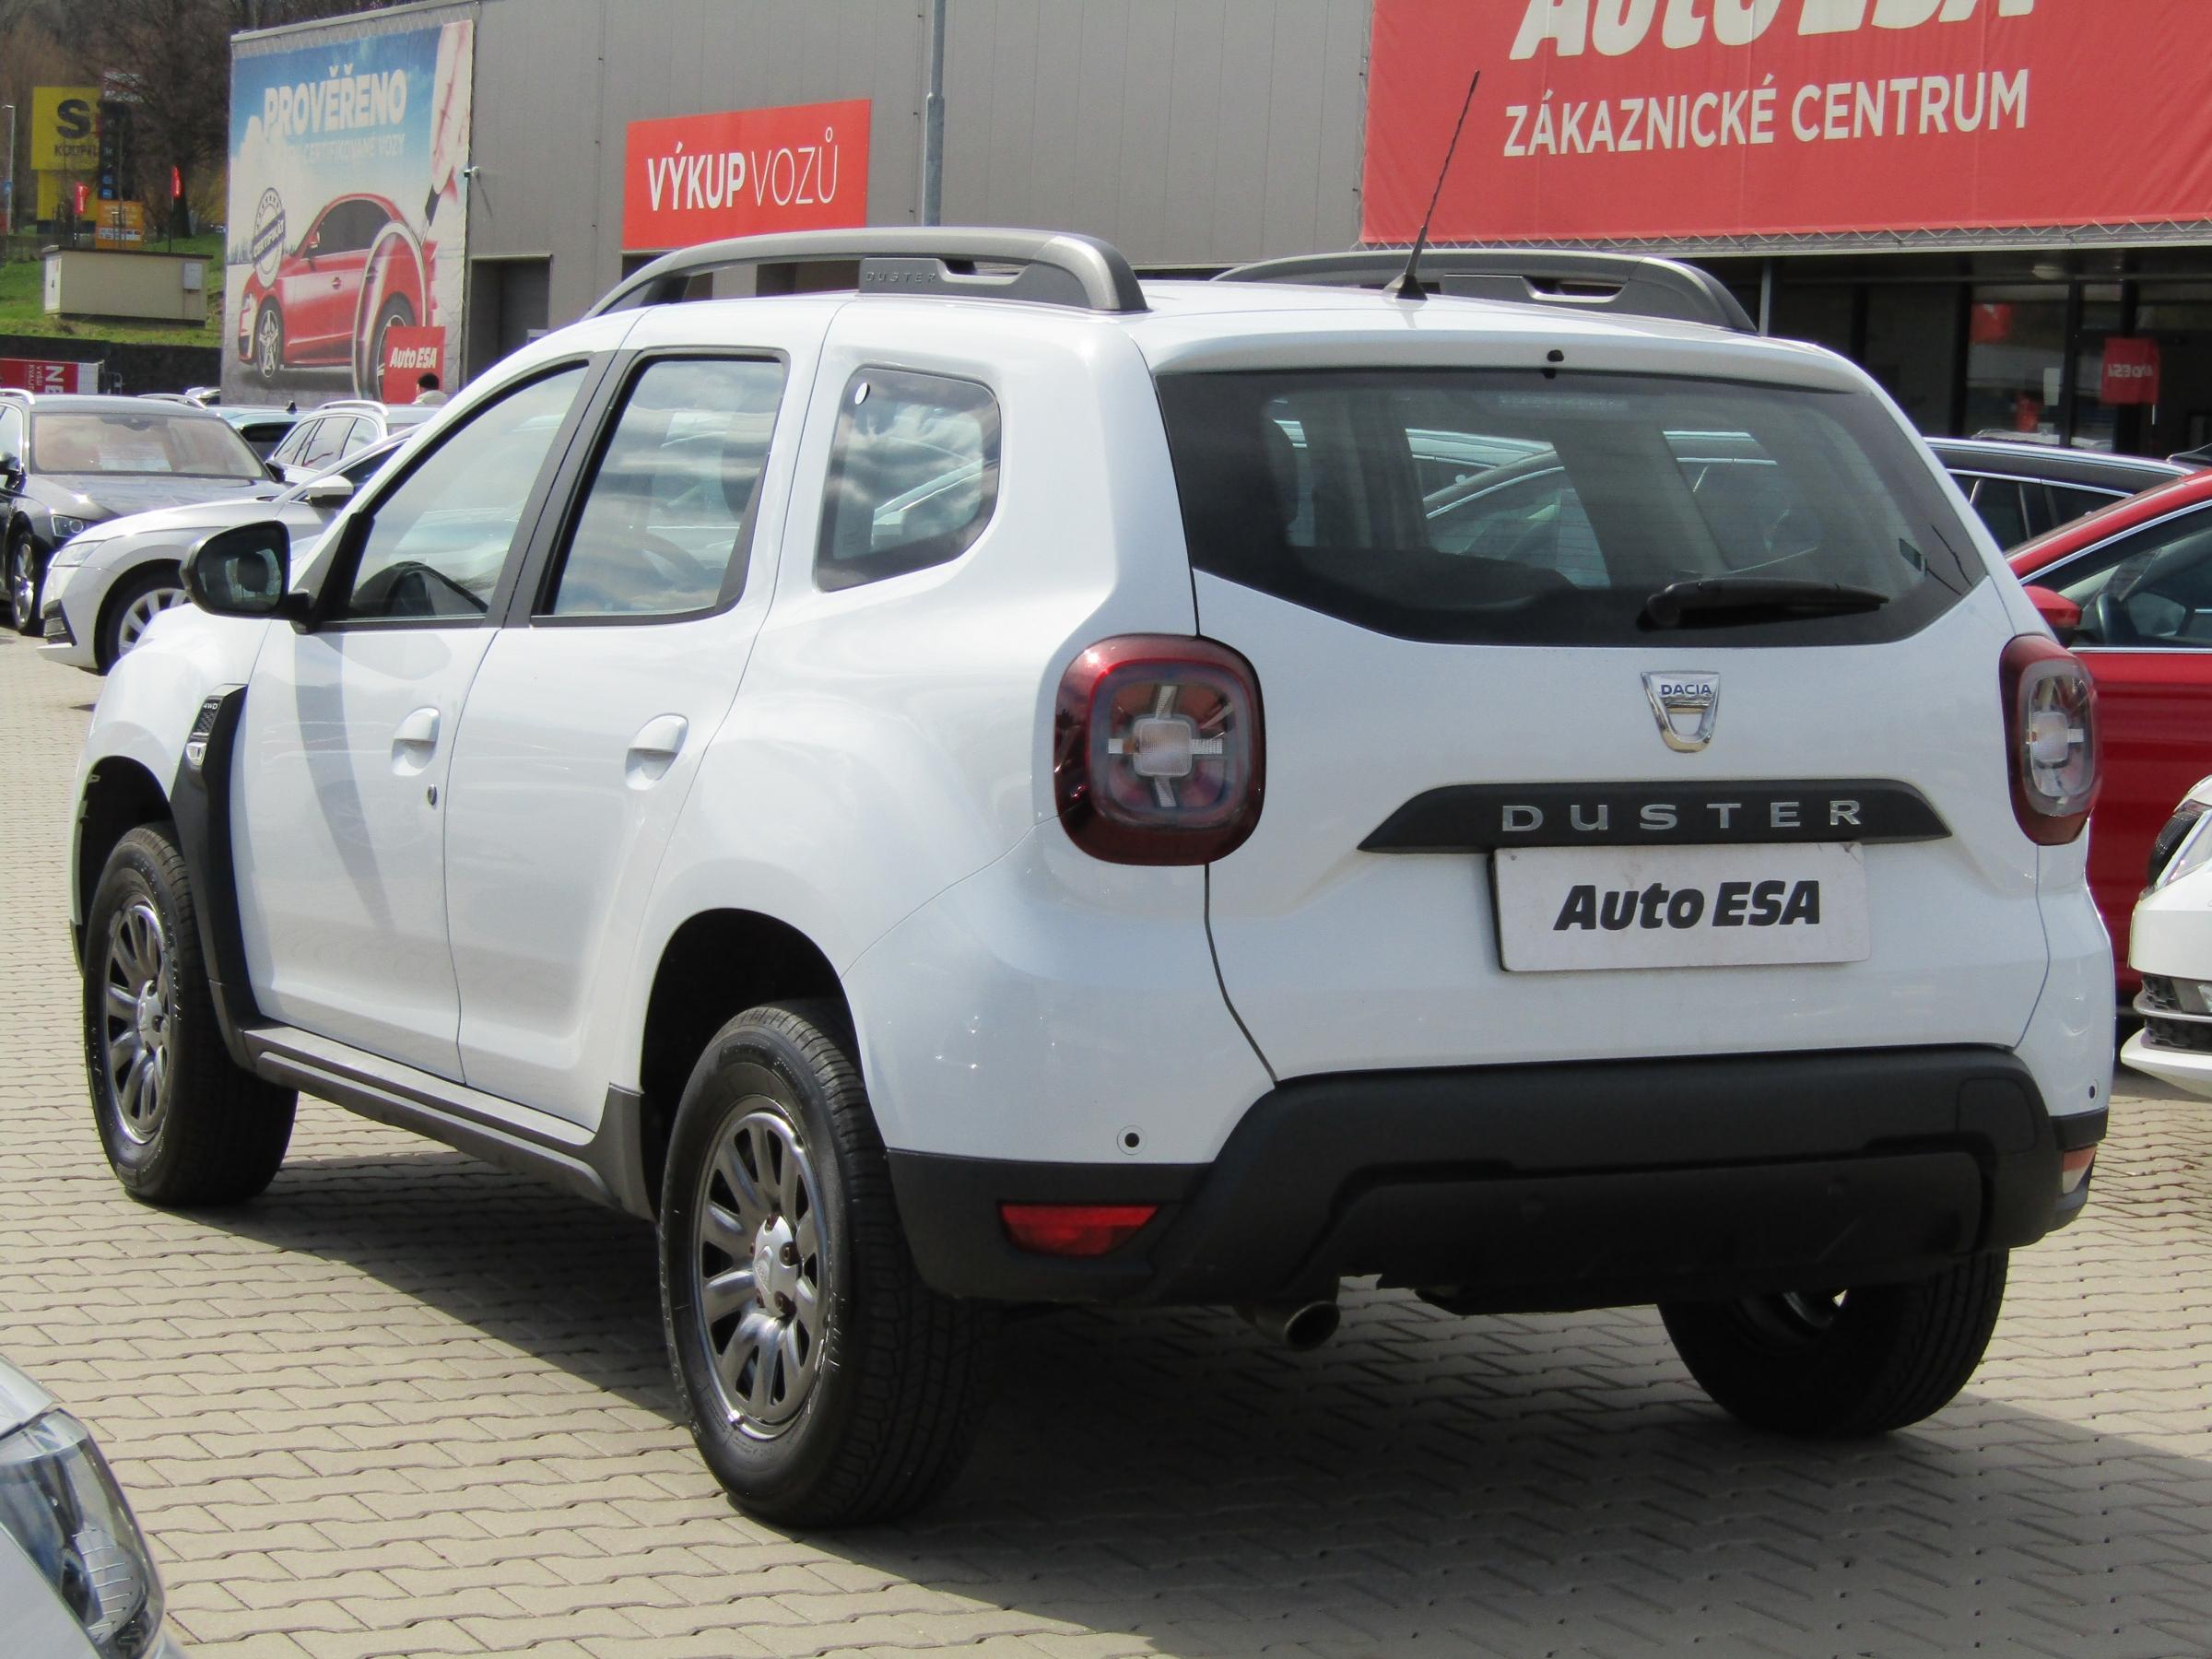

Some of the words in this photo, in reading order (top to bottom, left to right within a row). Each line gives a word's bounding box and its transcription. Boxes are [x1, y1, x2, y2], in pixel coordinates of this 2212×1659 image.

[264, 63, 407, 135] PROVĚŘENO
[1503, 74, 1777, 158] ZÁKAZNICKÉ
[1791, 68, 2030, 143] CENTRUM
[647, 142, 746, 212] VÝKUP
[750, 127, 839, 206] VOZŮ
[865, 272, 937, 283] DUSTER
[390, 347, 416, 369] Auto
[416, 347, 438, 369] ESA
[1661, 684, 1712, 695] DACIA
[1501, 799, 1863, 832] DUSTER
[1552, 881, 1704, 931] Auto
[1711, 879, 1820, 927] ESA
